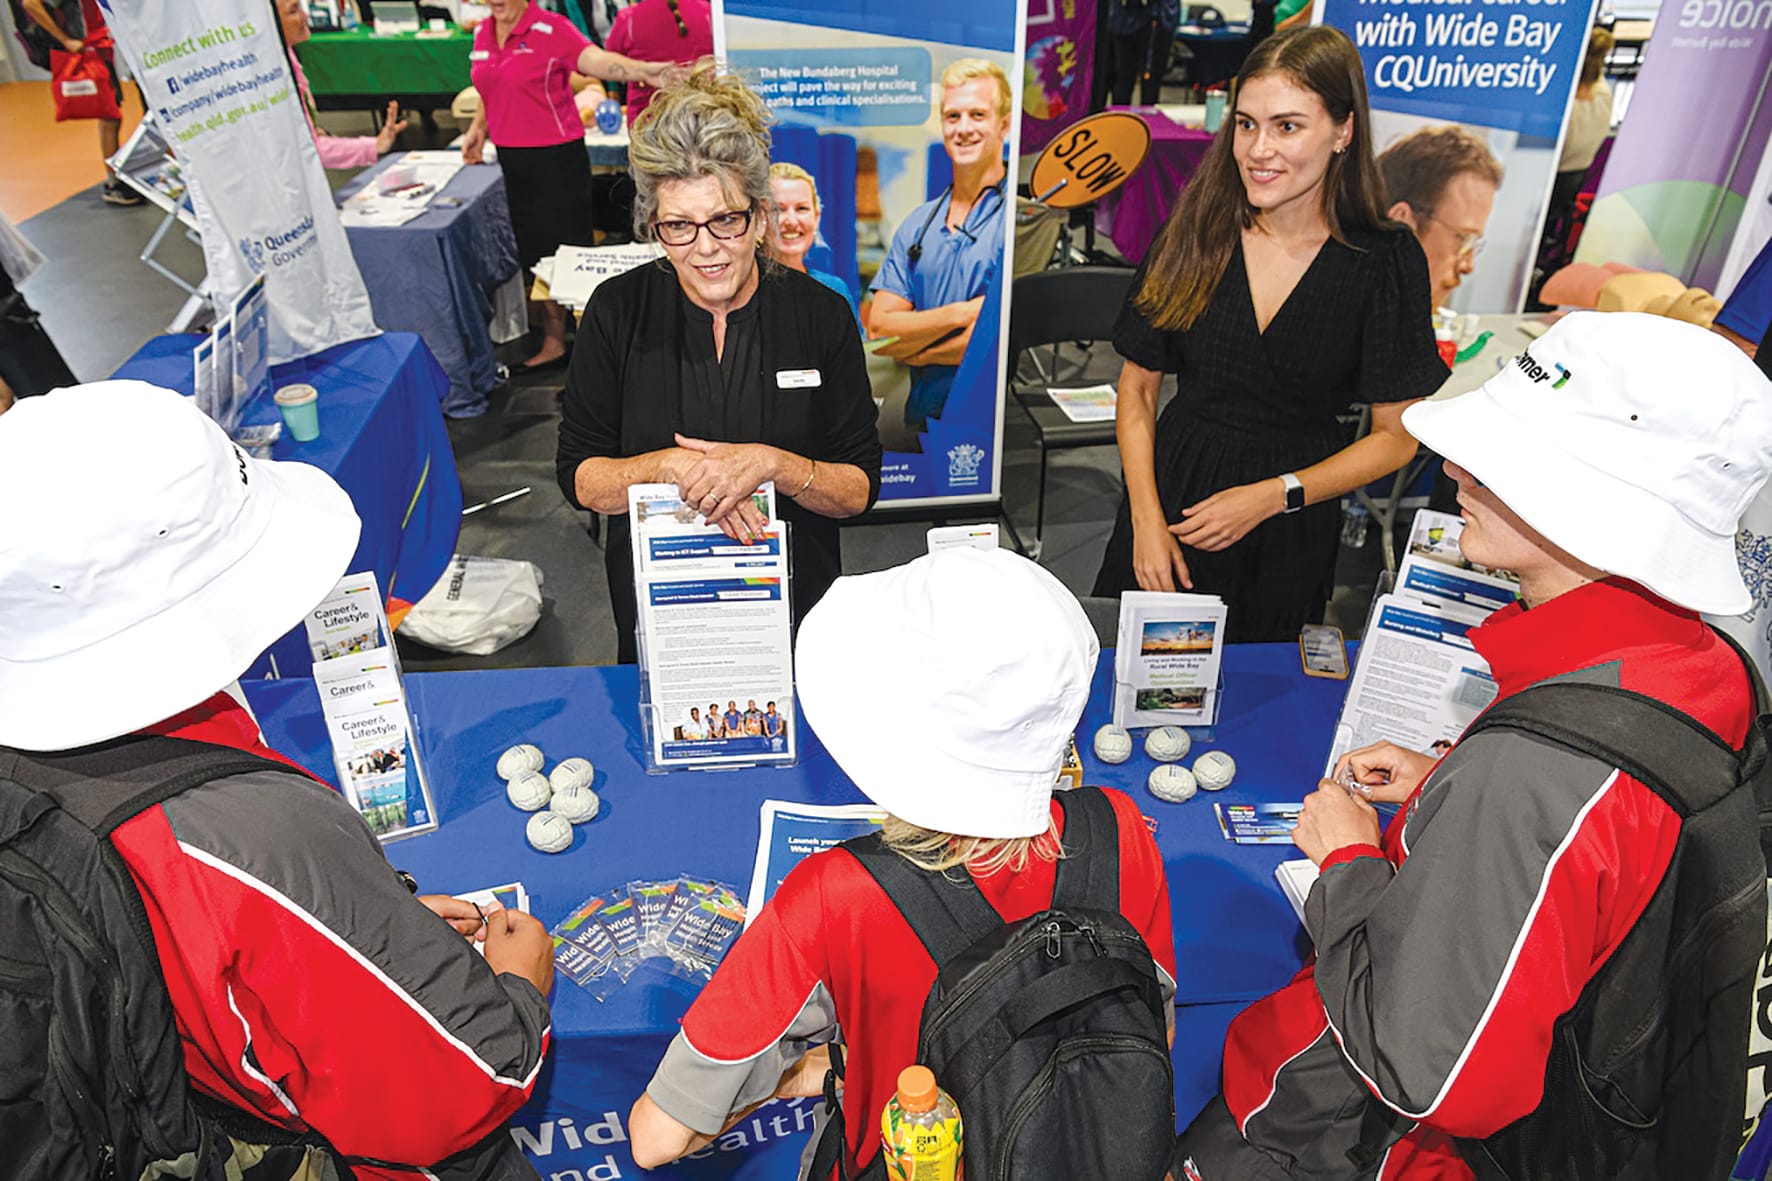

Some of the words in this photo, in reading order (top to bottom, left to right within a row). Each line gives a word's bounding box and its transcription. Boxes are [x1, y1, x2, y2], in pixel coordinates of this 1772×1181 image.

[1355, 12, 1417, 47] with
[1425, 12, 1499, 47] Wide
[1504, 14, 1562, 54] Bay
[142, 36, 197, 70] Connect
[198, 25, 236, 49] with
[238, 21, 256, 38] us
[760, 67, 777, 78] The
[779, 66, 801, 78] New
[802, 66, 856, 79] Bundaberg
[858, 65, 898, 77] Hospital
[1374, 54, 1557, 95] CQUniversity
[800, 82, 822, 94] pave
[824, 80, 840, 91] the
[842, 82, 862, 93] way
[863, 80, 876, 91] for
[878, 80, 917, 93] exciting
[796, 95, 814, 106] and
[816, 95, 851, 106] clinical
[1054, 129, 1126, 193] SLOW
[323, 611, 370, 628] Lifestyle
[351, 724, 397, 740] Lifestyle
[788, 836, 819, 845] Launch
[790, 845, 812, 853] Wide
[637, 901, 667, 914] Wide
[607, 916, 636, 932] Wide
[684, 911, 711, 929] Wide
[712, 921, 733, 937] Bay
[575, 923, 601, 945] Wide
[556, 943, 579, 965] Wid
[509, 1111, 629, 1158] Wid
